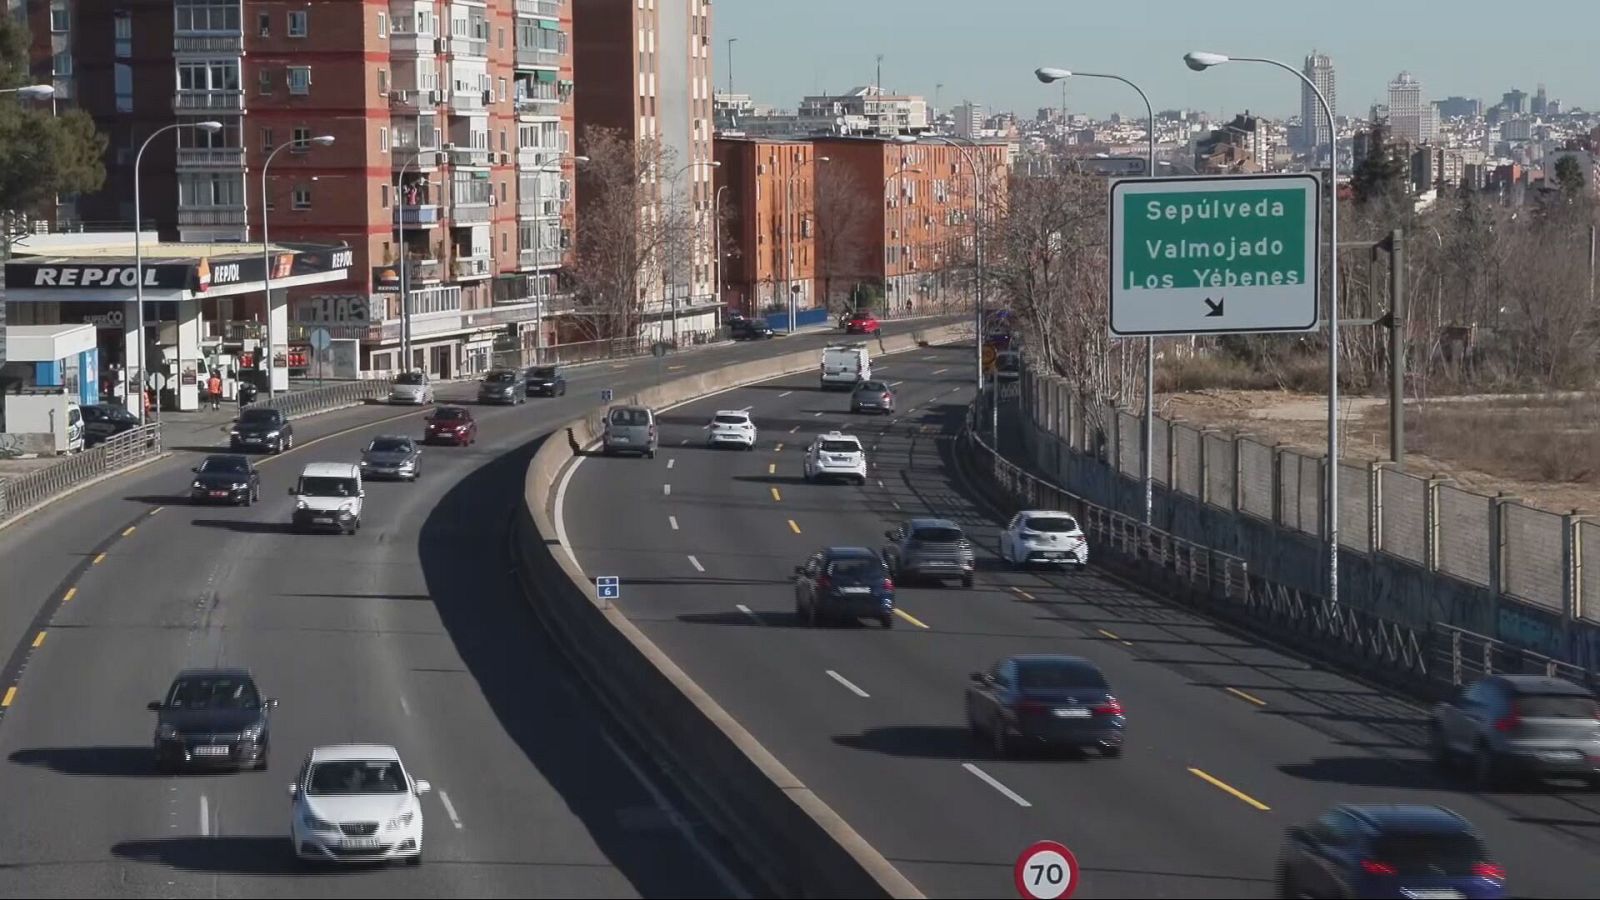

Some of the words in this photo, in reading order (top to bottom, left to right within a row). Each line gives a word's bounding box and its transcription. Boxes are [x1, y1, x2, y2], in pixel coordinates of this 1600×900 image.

[1146, 199, 1284, 224] Sepúlveda
[1146, 236, 1284, 261] Valmojado
[332, 250, 353, 268] REPSOL
[35, 268, 160, 286] REPSOL
[214, 263, 240, 283] REPSOL
[1129, 271, 1174, 289] Los
[1193, 268, 1299, 288] Yébenes
[604, 587, 611, 596] 6
[1030, 863, 1063, 886] 70
